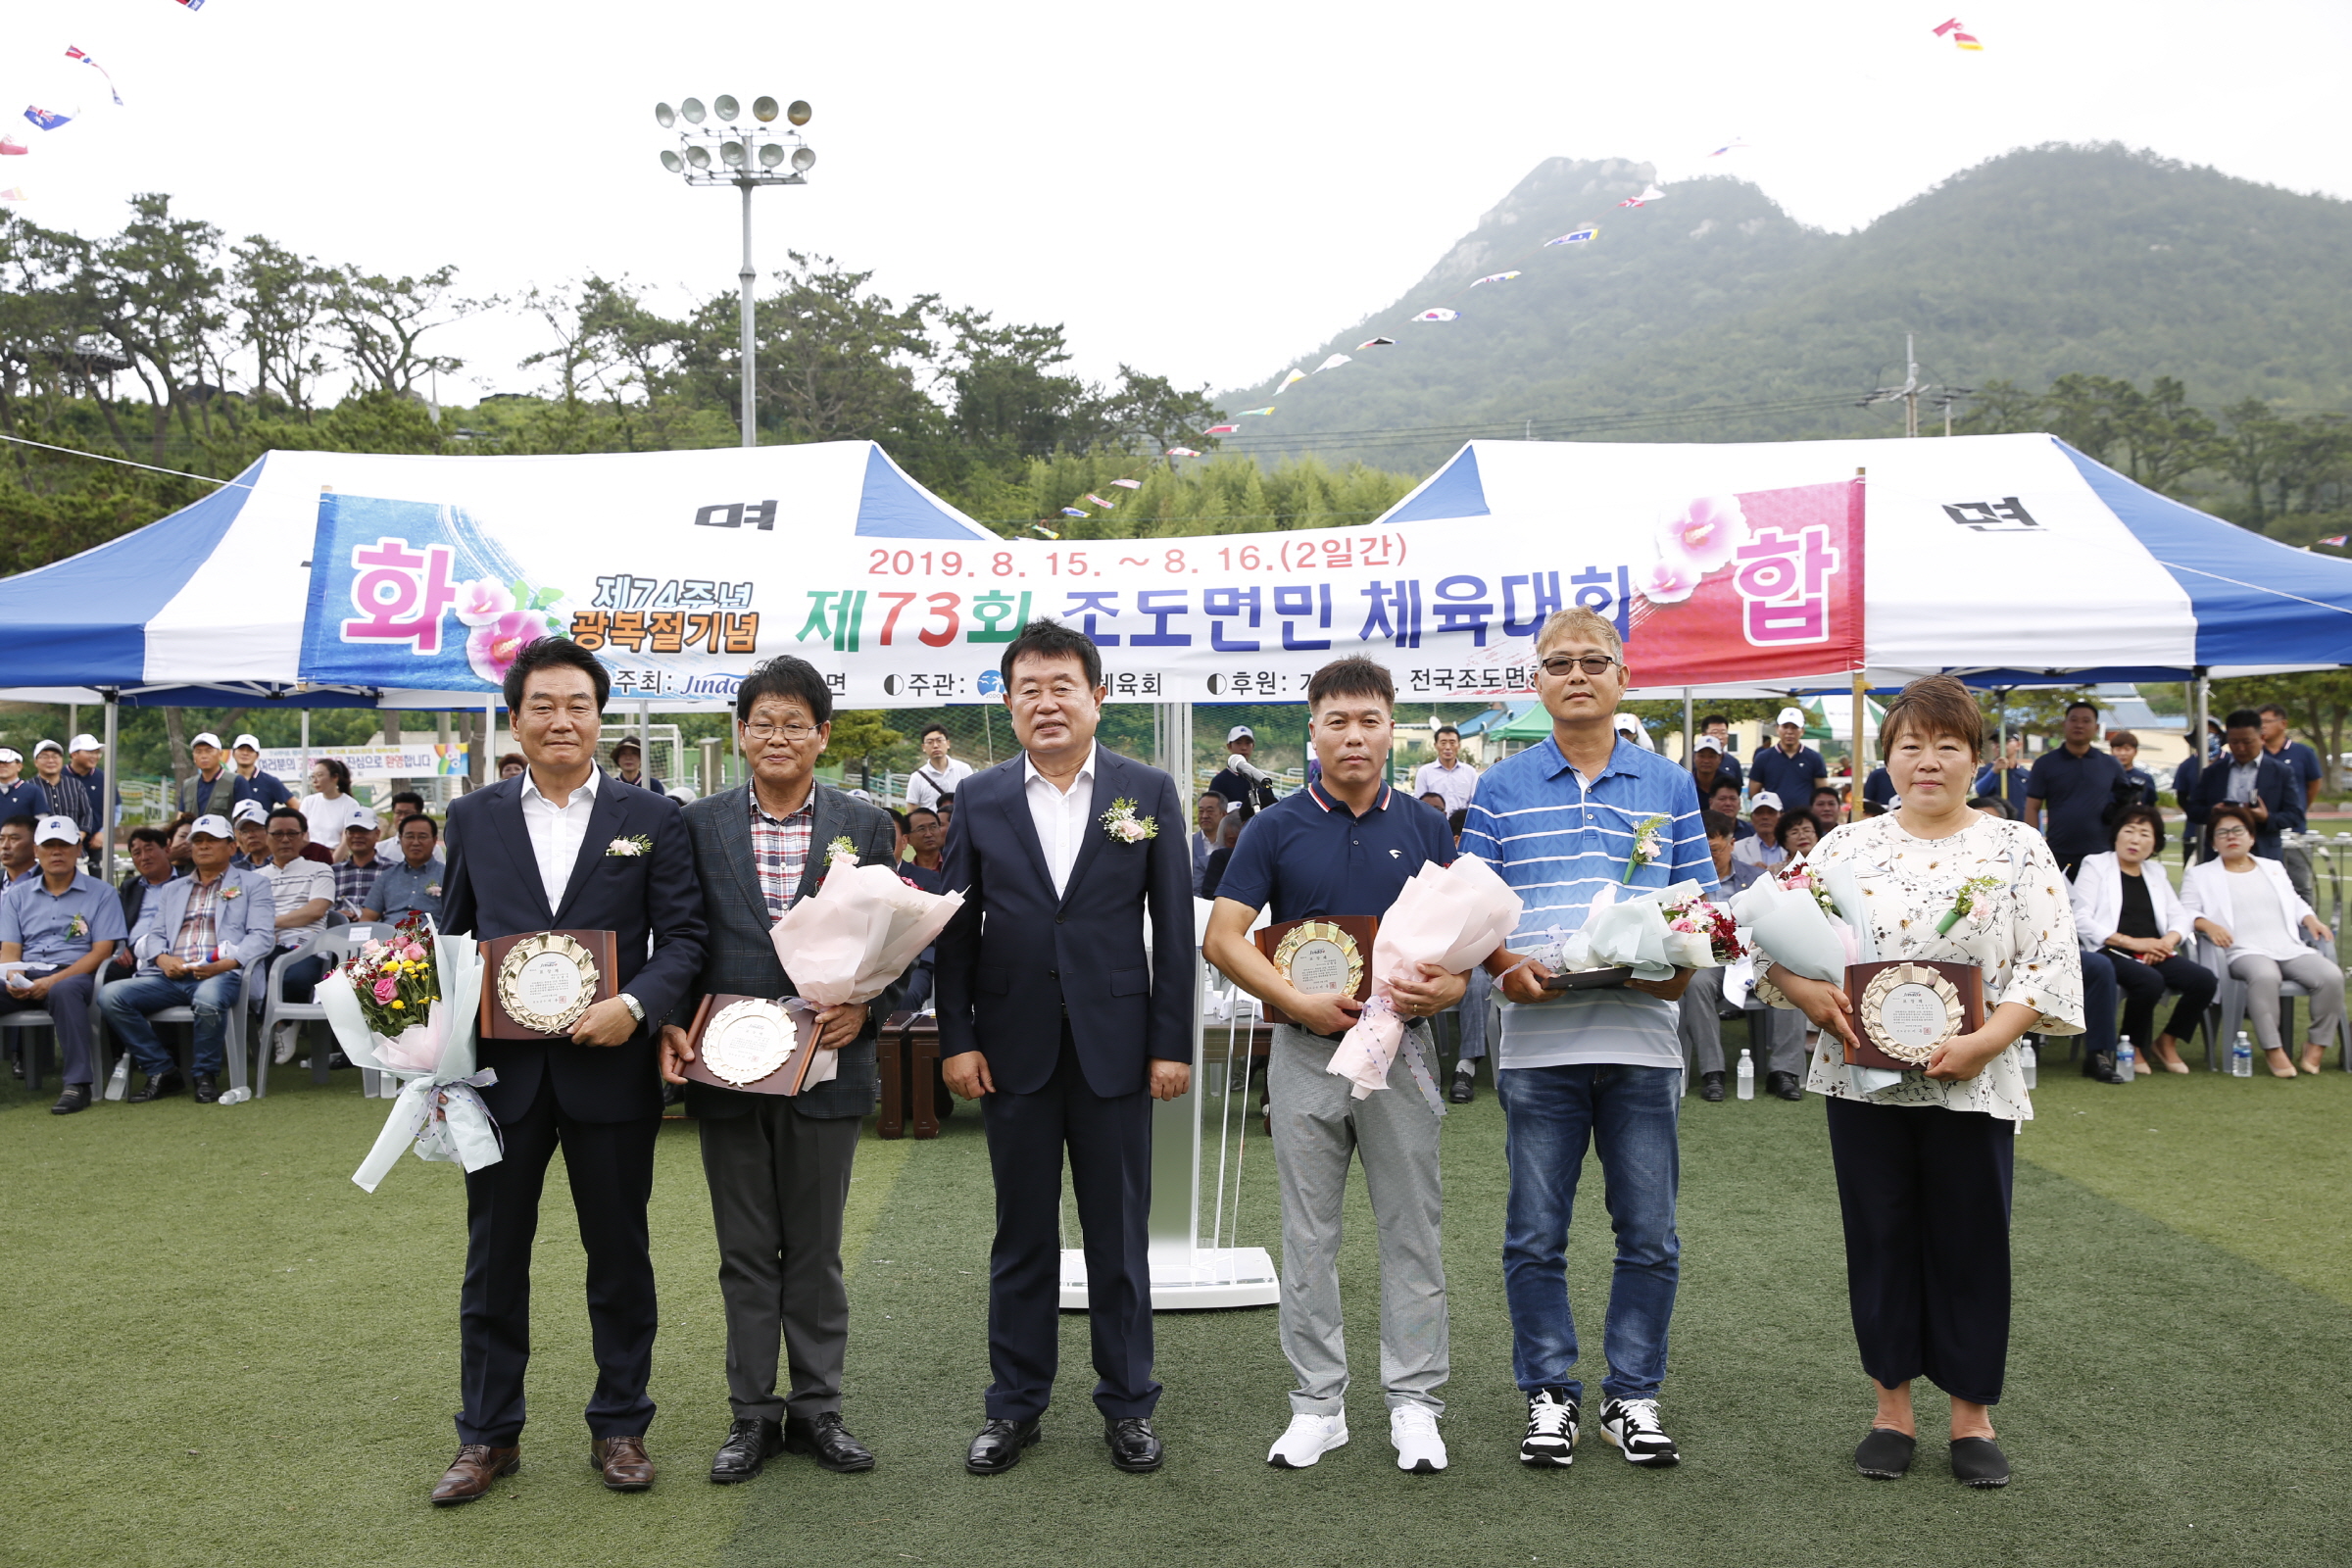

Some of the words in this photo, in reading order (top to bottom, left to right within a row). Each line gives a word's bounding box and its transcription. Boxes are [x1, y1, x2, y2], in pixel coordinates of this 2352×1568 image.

[868, 549, 974, 577] 2019.
[992, 552, 1025, 577] 8.
[1046, 552, 1101, 577] 15.
[1164, 549, 1199, 573] 8.
[342, 538, 457, 654] 화
[591, 573, 754, 610] 제74주년
[1733, 526, 1838, 645] 합
[795, 589, 1032, 653] 제73회
[1061, 583, 1332, 653] 조도면민
[1358, 565, 1631, 649] 체육대회
[569, 610, 760, 655] 광복절기념
[614, 669, 672, 696] 주최:
[907, 672, 965, 697] 주관:
[1231, 670, 1287, 696] 후원:
[346, 755, 383, 769] 진심으로
[385, 754, 431, 769] 환영합니다
